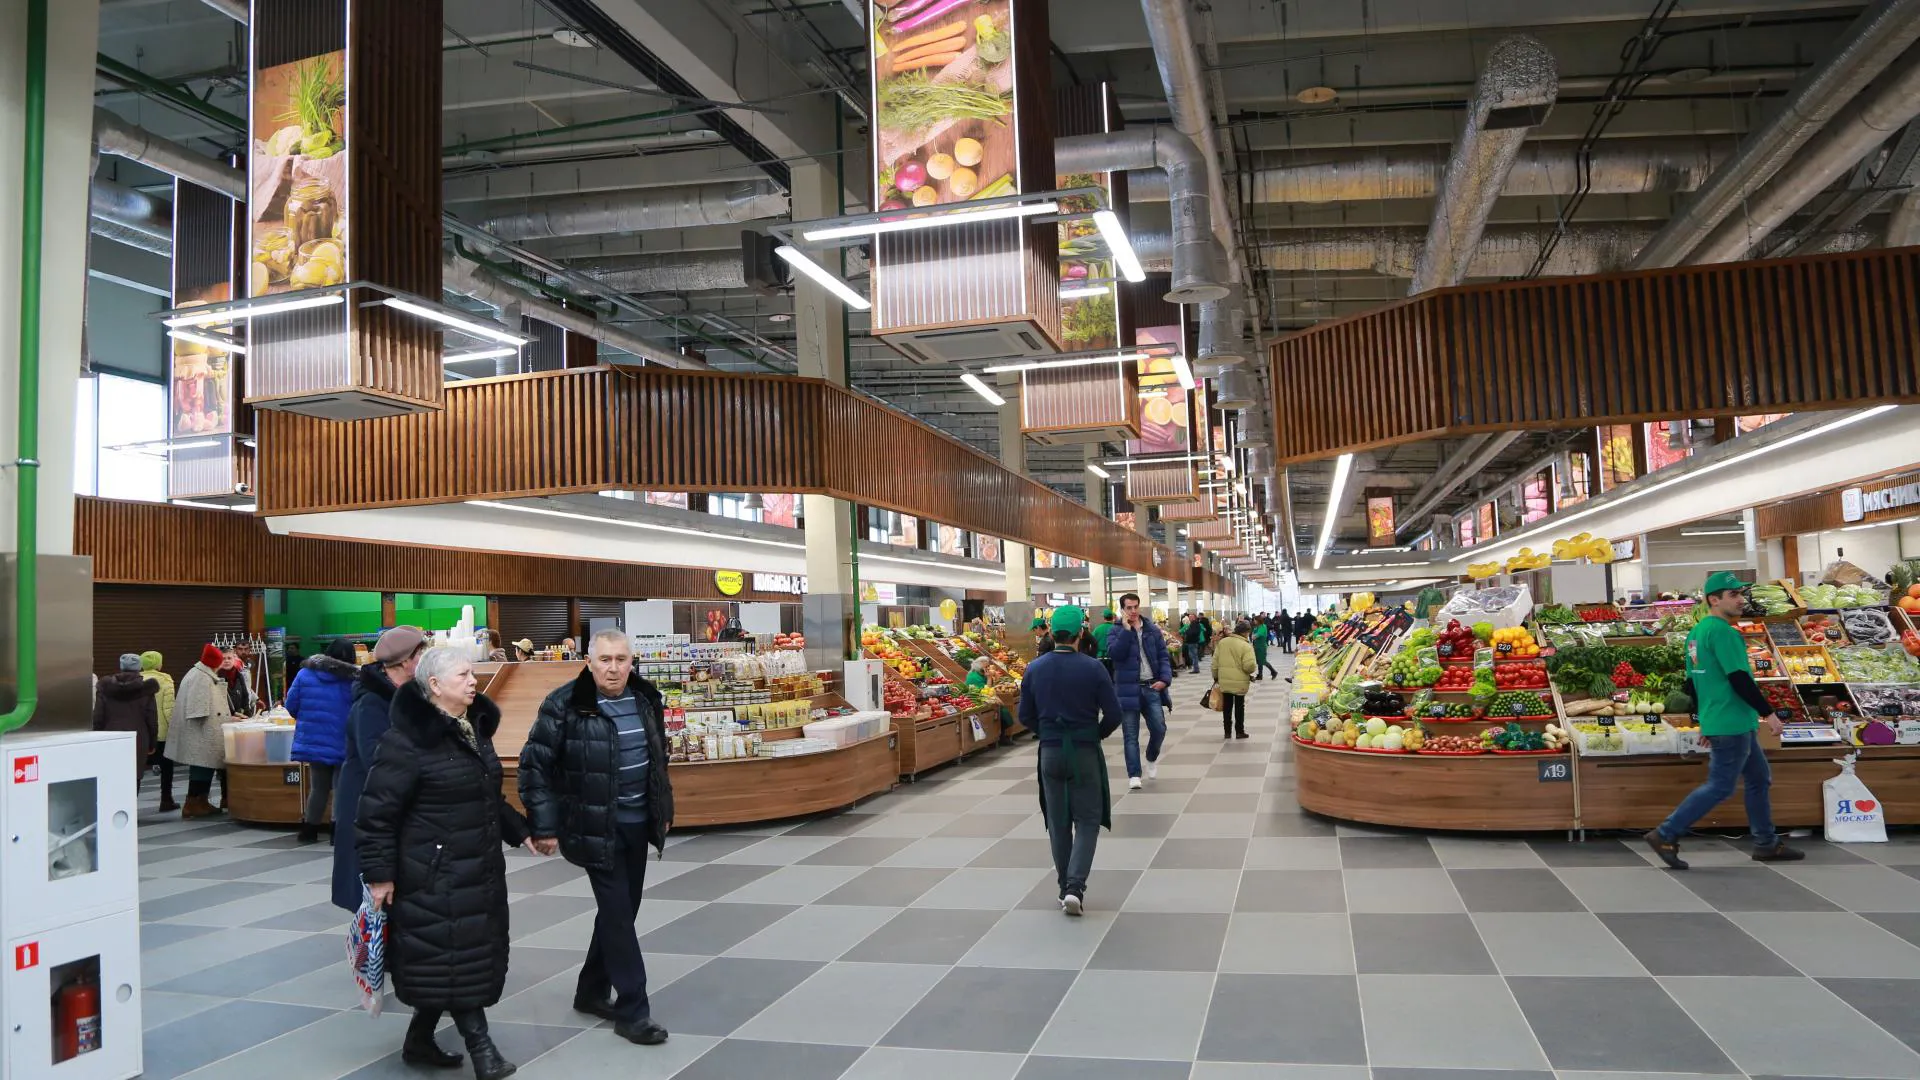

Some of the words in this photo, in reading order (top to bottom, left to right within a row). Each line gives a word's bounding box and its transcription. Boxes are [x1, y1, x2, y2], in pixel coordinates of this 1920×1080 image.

[1498, 643, 1512, 652] 220
[1836, 799, 1853, 814] Я
[1834, 815, 1876, 824] МОСКВУ
